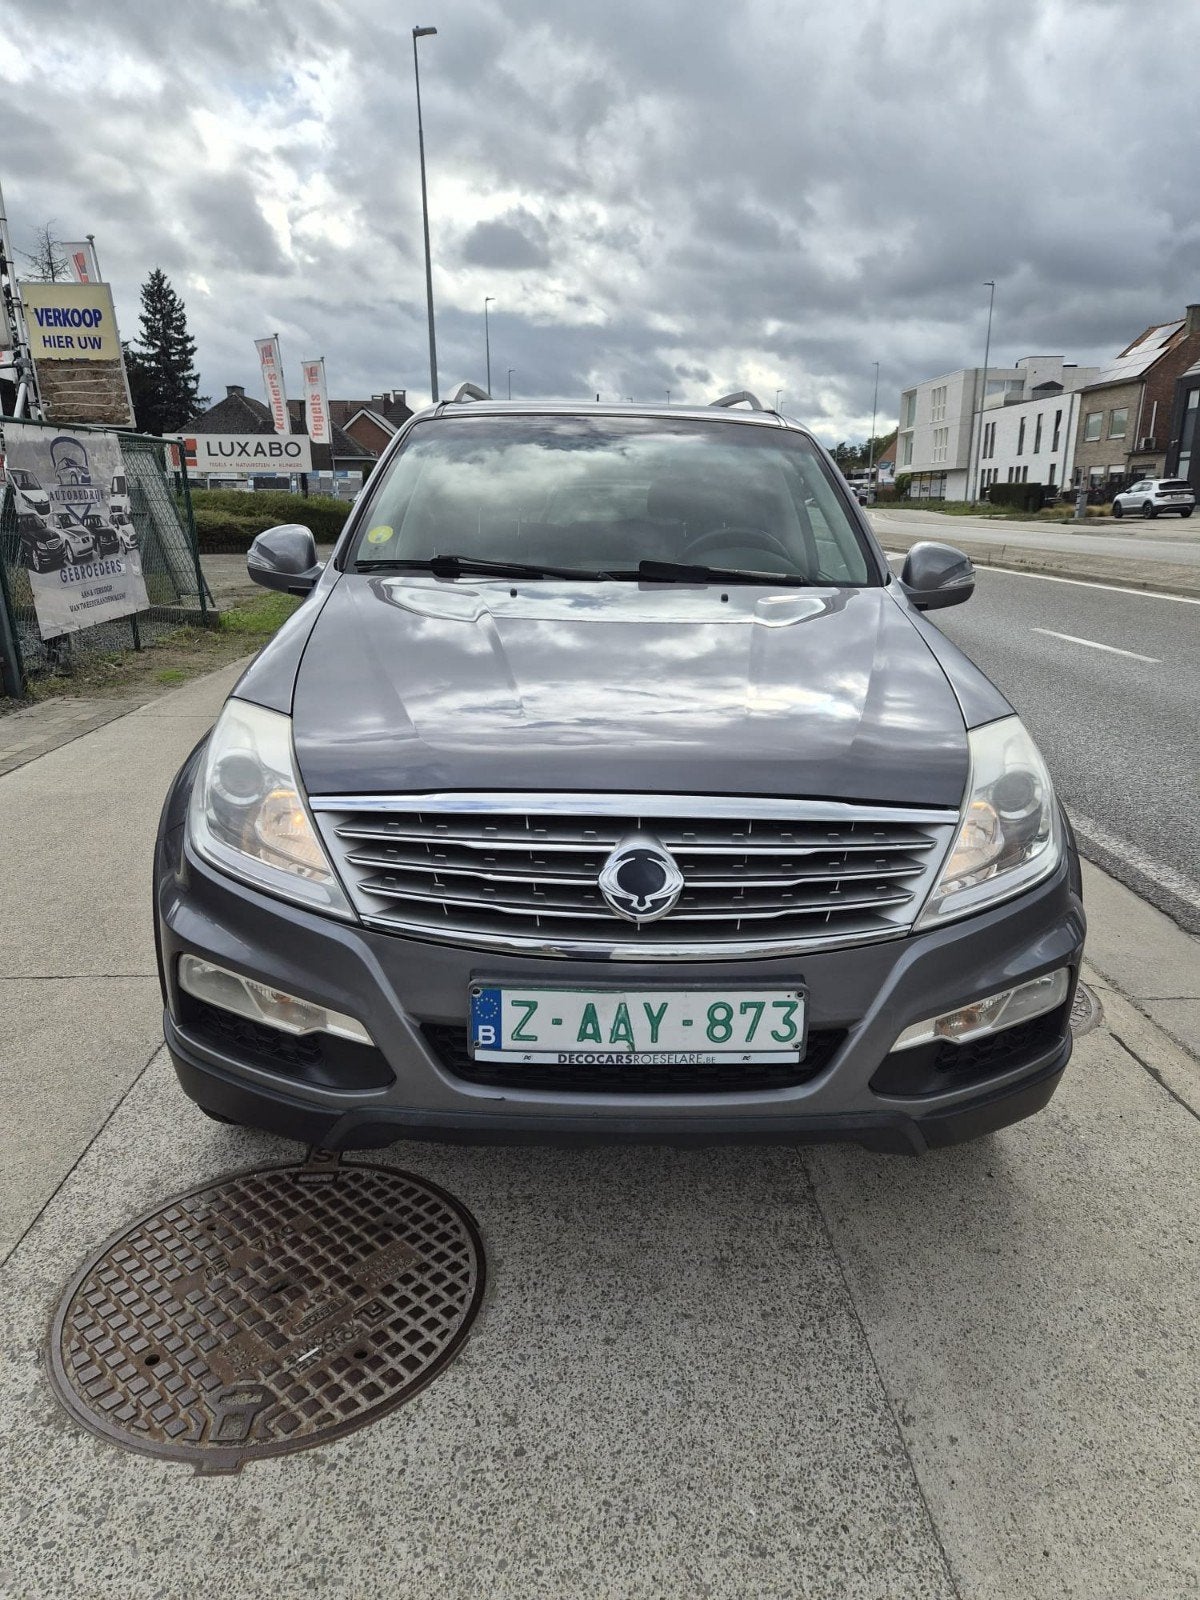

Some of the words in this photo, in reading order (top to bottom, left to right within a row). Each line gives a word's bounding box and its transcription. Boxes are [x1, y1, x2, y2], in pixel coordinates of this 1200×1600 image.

[34, 307, 103, 328] VERKOOP
[42, 335, 75, 349] HIER
[78, 336, 102, 349] UW
[310, 393, 324, 438] Tegels
[206, 441, 302, 458] LUXABO
[60, 560, 122, 583] GEBROEDERS
[477, 1025, 496, 1045] B
